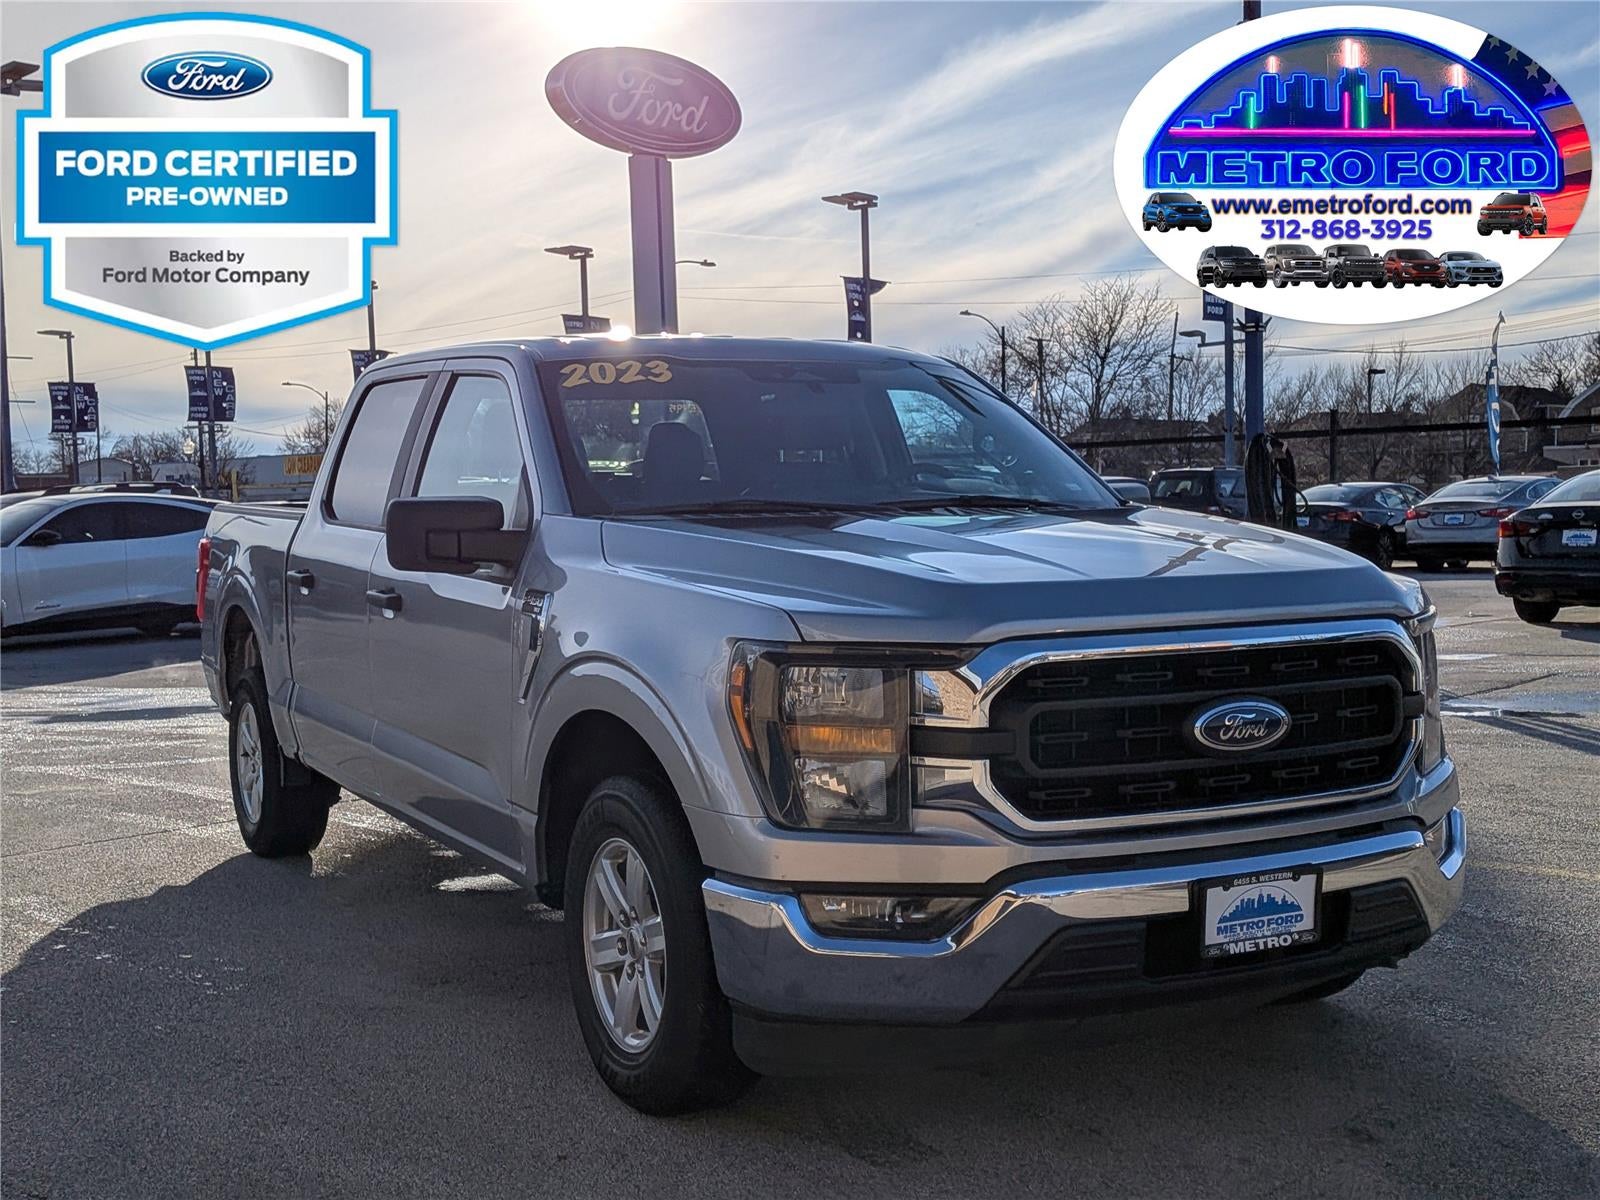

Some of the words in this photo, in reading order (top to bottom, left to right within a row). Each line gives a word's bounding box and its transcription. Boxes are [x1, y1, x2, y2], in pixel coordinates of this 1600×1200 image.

[608, 66, 710, 134] Ford
[1206, 305, 1224, 315] FORD
[560, 360, 673, 388] 2023
[1219, 713, 1269, 740] Ford
[1259, 872, 1293, 882] WESTERN
[1216, 920, 1266, 937] METRO
[1266, 913, 1304, 930] FORD
[1229, 934, 1293, 955] METRO
